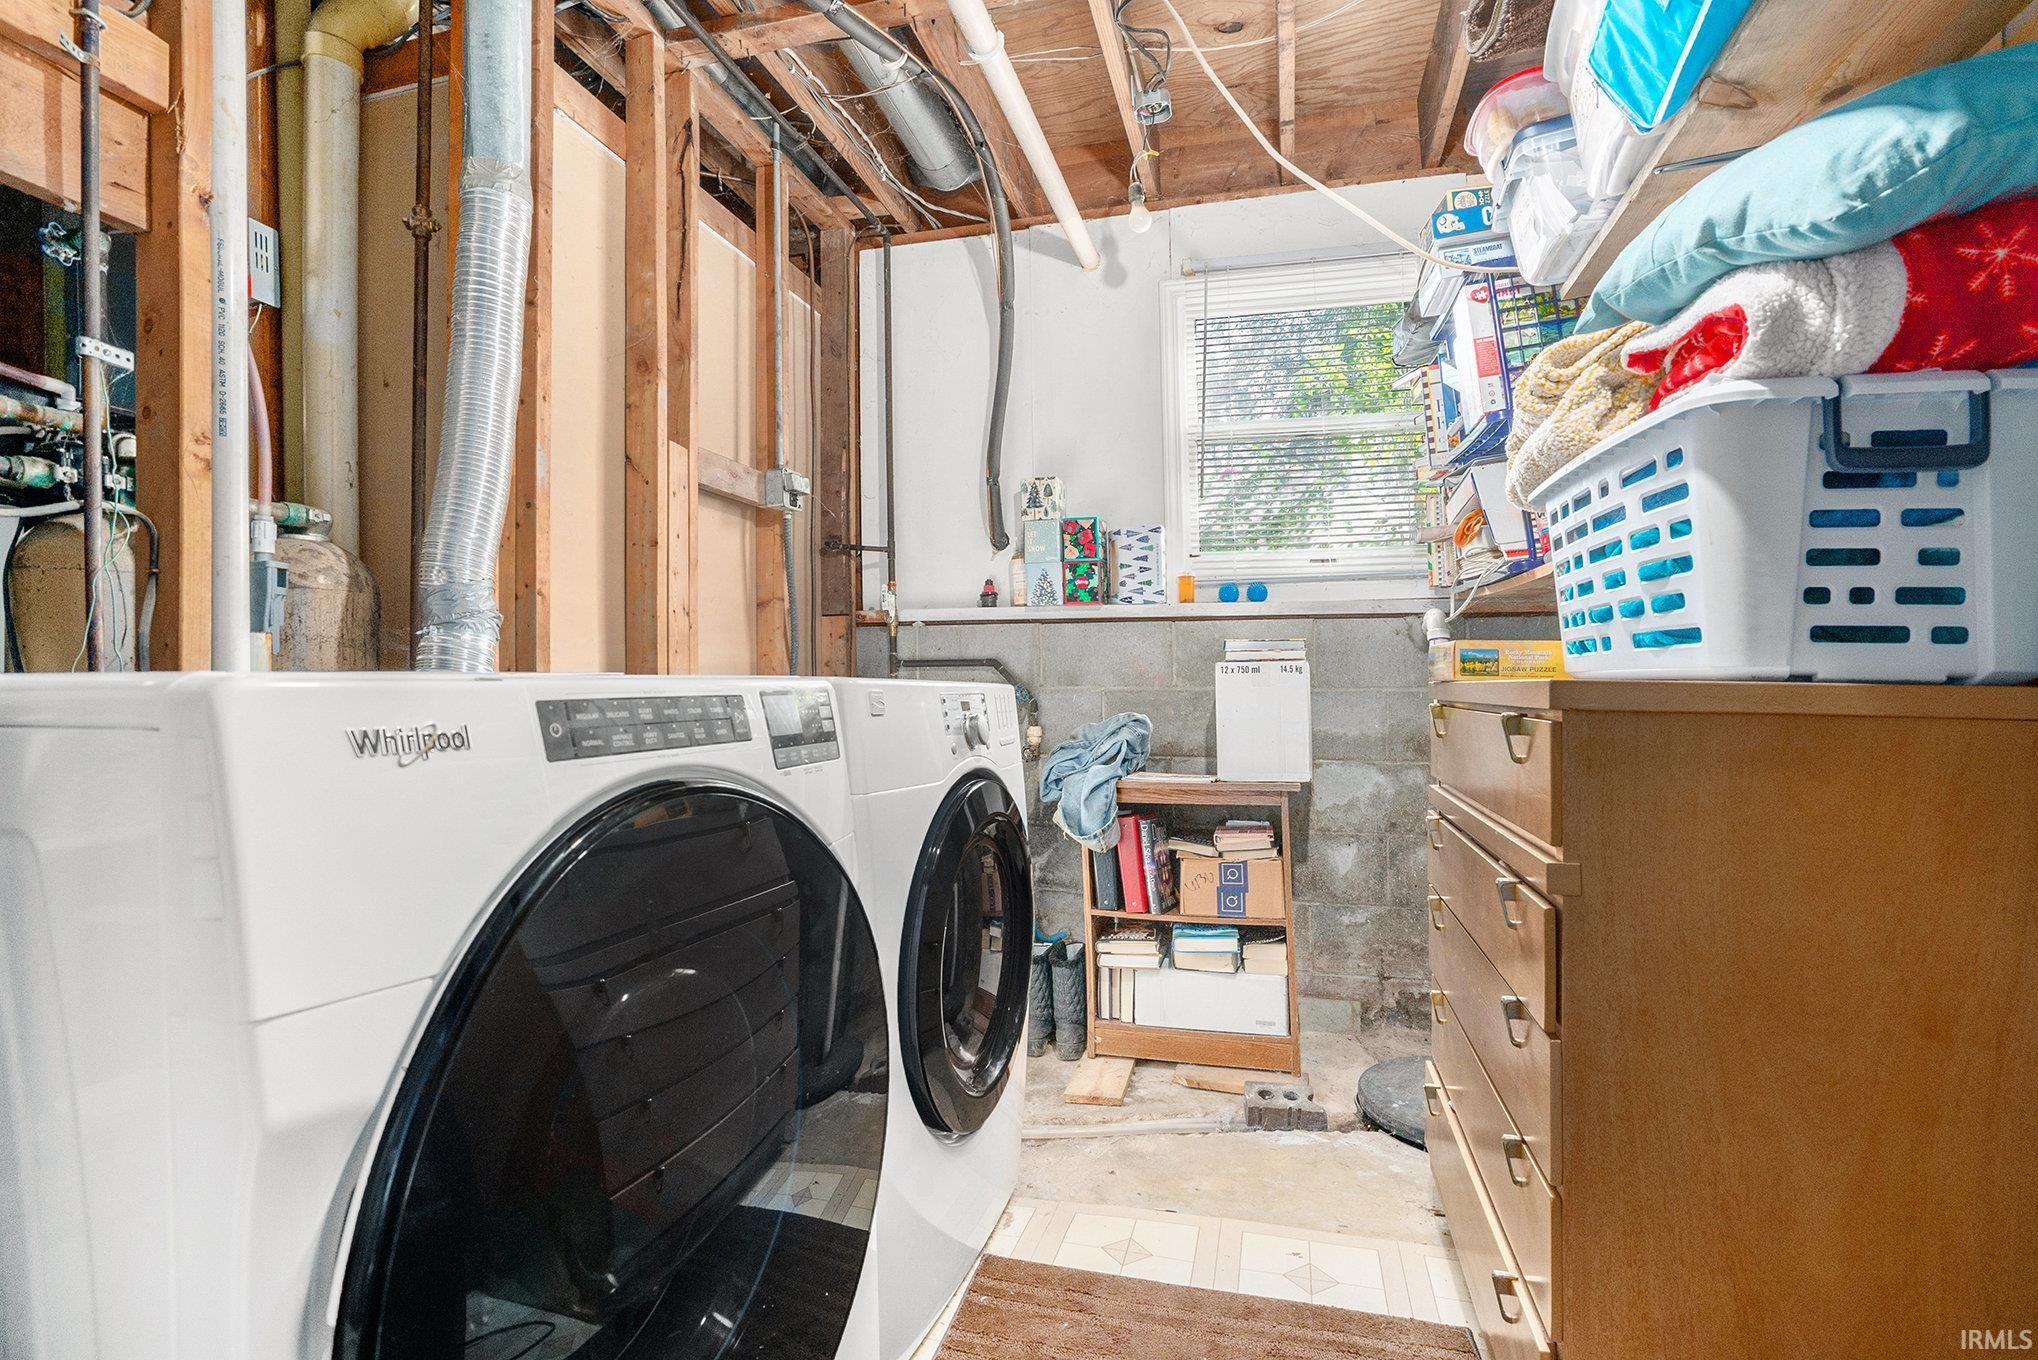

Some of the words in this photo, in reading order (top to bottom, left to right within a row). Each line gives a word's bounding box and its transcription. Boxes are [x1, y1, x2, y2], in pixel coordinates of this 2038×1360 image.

[218, 306, 226, 320] PVC
[1027, 544, 1046, 552] SNOW
[1221, 665, 1229, 674] 12
[1237, 665, 1250, 674] 750
[1251, 665, 1260, 674] ml
[1280, 665, 1294, 674] 14.5
[1295, 665, 1303, 675] kg
[345, 724, 471, 761] Whirlpool
